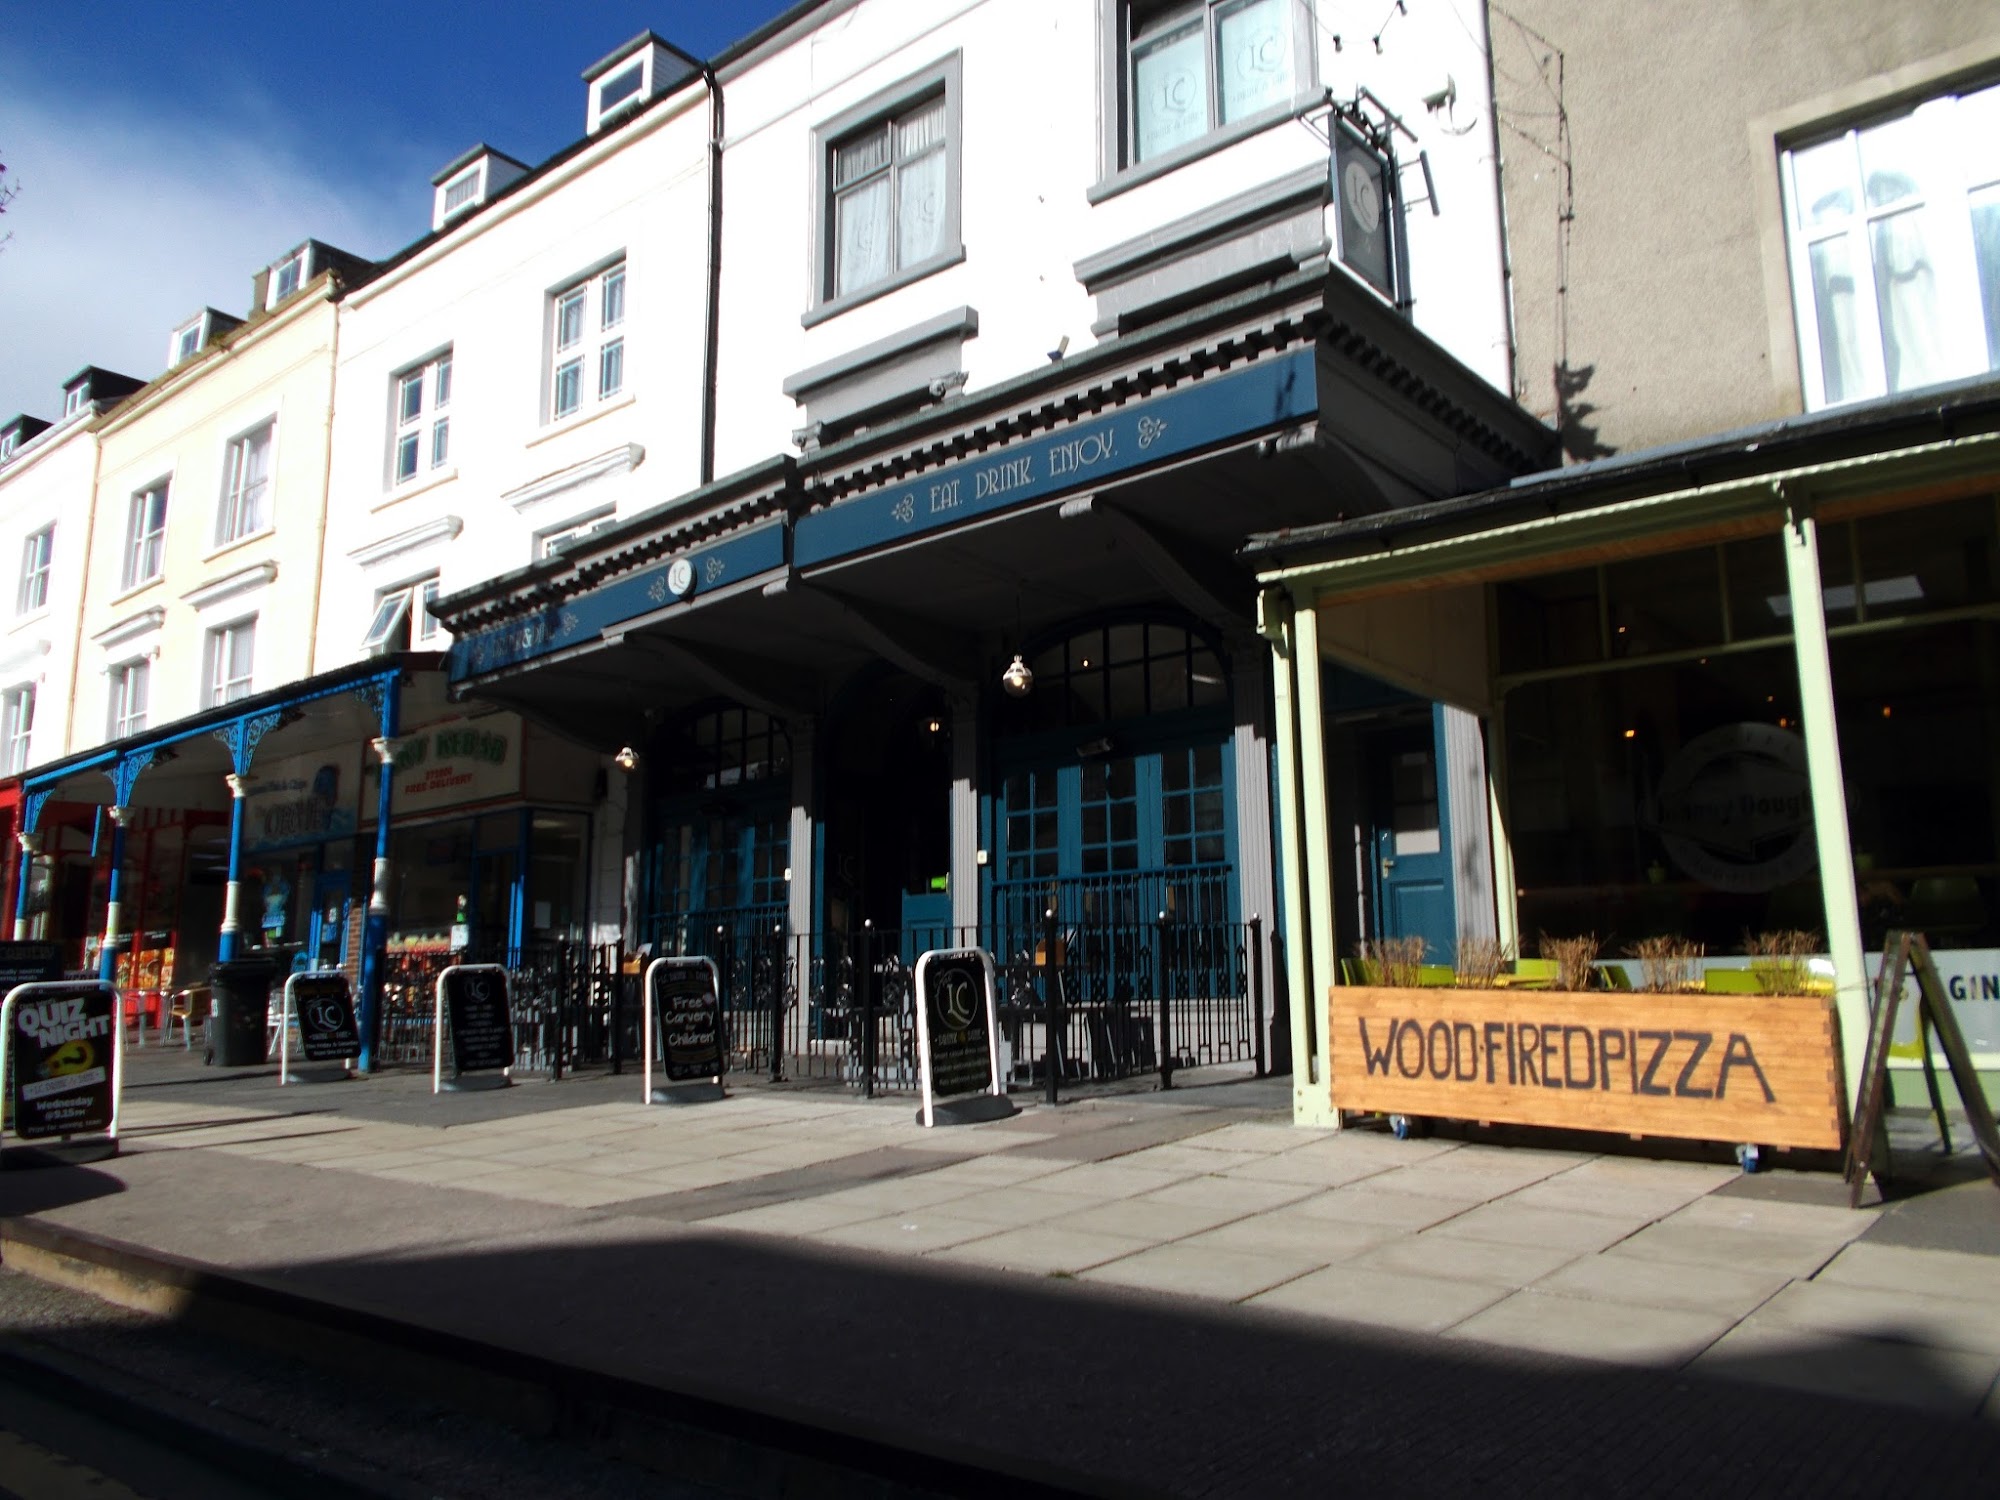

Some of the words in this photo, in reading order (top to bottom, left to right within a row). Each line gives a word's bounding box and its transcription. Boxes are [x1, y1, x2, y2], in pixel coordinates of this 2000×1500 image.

[930, 479, 963, 513] EAT.
[976, 456, 1035, 499] DRINK.
[430, 773, 472, 789] DELIVERY
[1949, 975, 2000, 1001] GIN
[673, 995, 703, 1010] Free
[18, 997, 86, 1038] QUIZ
[665, 1010, 715, 1027] Carvery
[38, 1014, 110, 1049] NIGHT
[668, 1029, 716, 1047] Children
[36, 1096, 94, 1111] Wednesday
